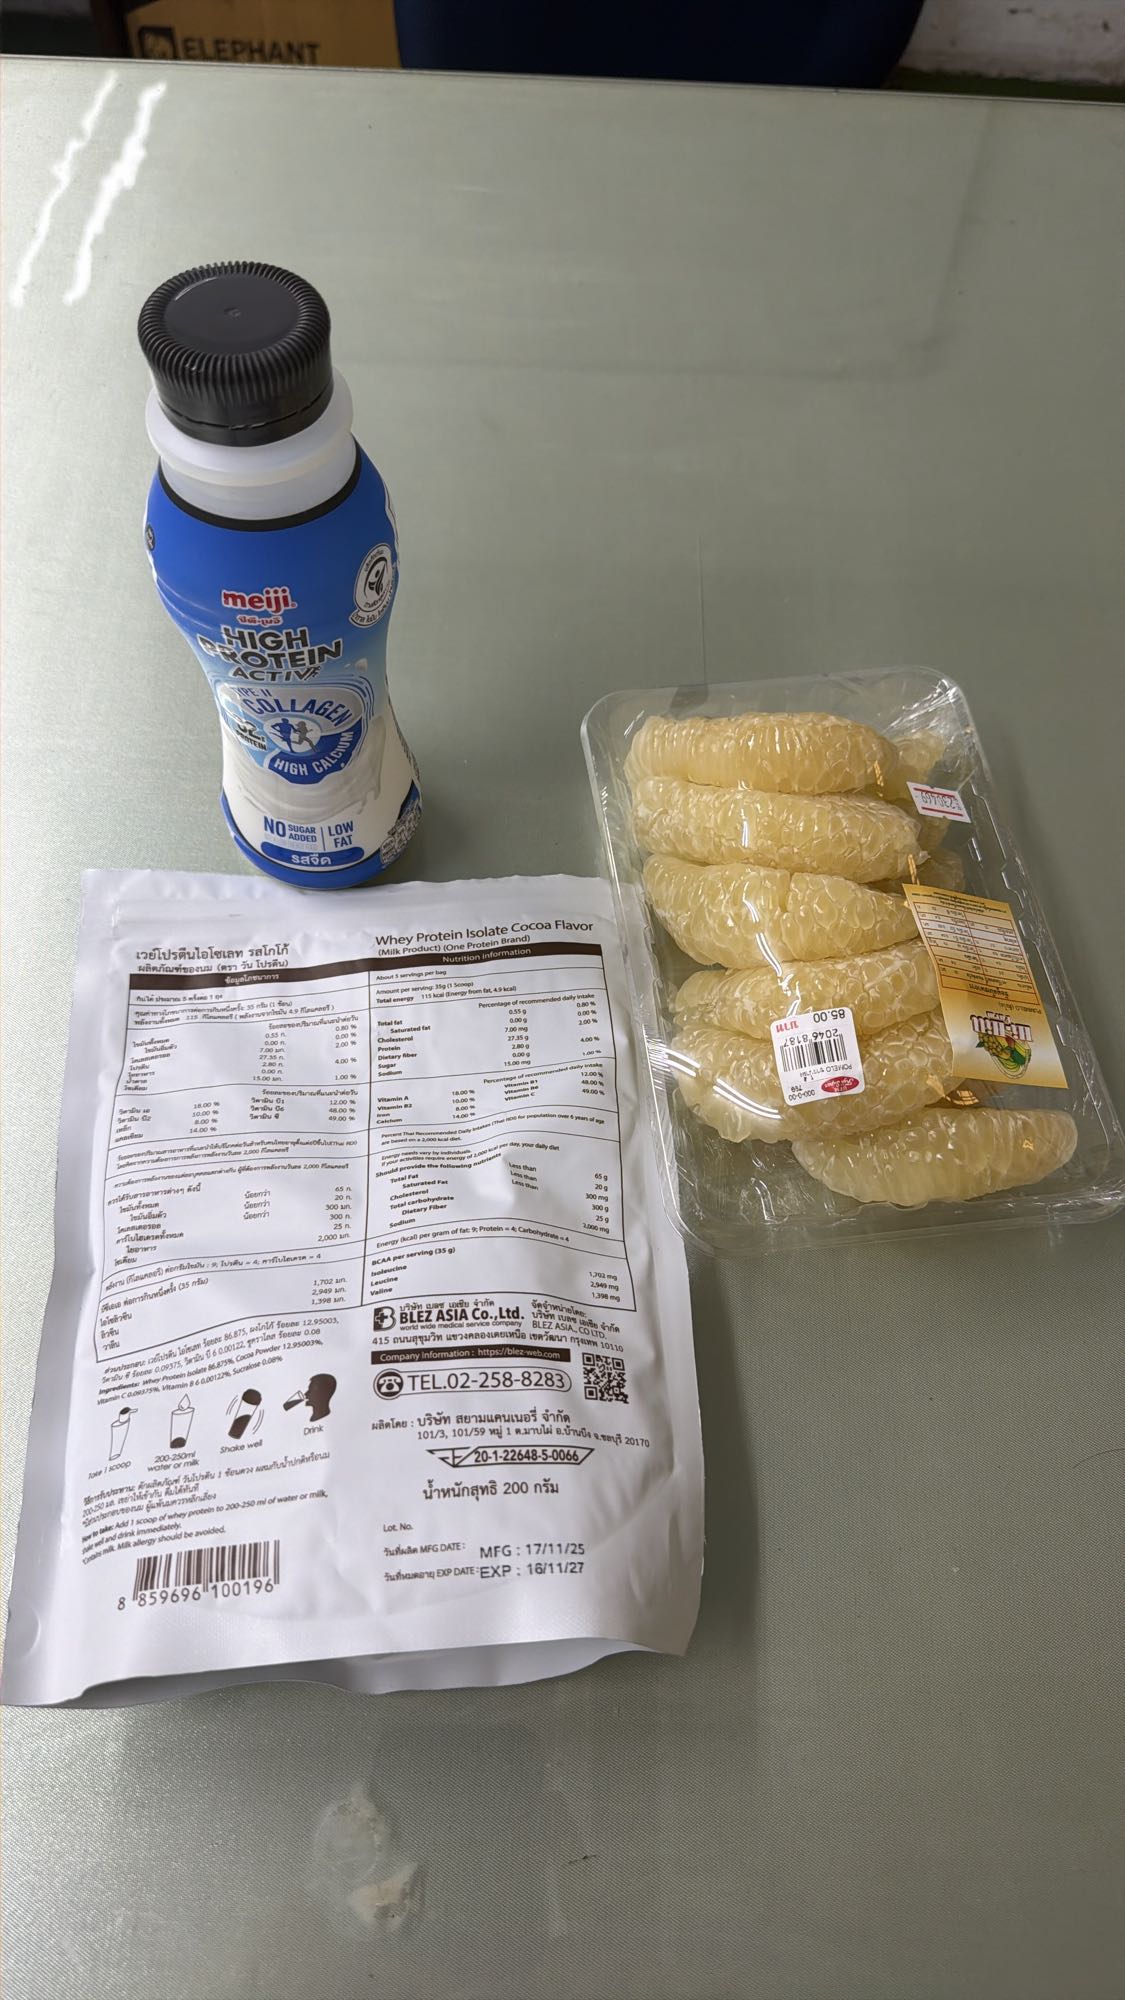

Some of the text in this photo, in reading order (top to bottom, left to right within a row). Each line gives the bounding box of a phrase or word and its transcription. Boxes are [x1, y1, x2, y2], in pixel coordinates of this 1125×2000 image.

[182, 37, 320, 65] ELEPHANT
[222, 587, 291, 614] meiji
[222, 626, 308, 650] HIGH
[198, 634, 342, 669] PROTEIN
[242, 698, 352, 726] COLLAGEN
[274, 732, 354, 776] HIGH CALCIUM
[264, 816, 286, 837] NO
[288, 824, 316, 834] SUGAR
[328, 821, 354, 836] LOW
[288, 834, 317, 842] ADDED
[334, 835, 353, 848] FAT
[291, 854, 331, 865] รสจืด
[376, 920, 593, 946] Whey Protein Isolate Cocoa Flavor
[136, 943, 289, 961] เวย์โปรตีนไอโซเลท รสโกโก้
[403, 945, 440, 954] Product)
[443, 944, 464, 952] (One
[467, 938, 499, 950] Protein
[501, 935, 530, 945] Brand)
[443, 948, 531, 963] Nutrition Information
[217, 964, 237, 972] (ตรา
[241, 961, 253, 969] วัน
[256, 960, 289, 968] โปรตีน)
[813, 1009, 846, 1023] 85.00
[776, 1020, 799, 1032] บาท
[783, 1028, 838, 1047] 2046 8187
[377, 1237, 398, 1248] Energy
[400, 1233, 418, 1243] (kcal)
[431, 1230, 449, 1238] gram
[518, 1226, 558, 1240] Carbohydrate
[372, 1257, 391, 1266] BCAA
[406, 1249, 433, 1258] serving
[371, 1264, 407, 1276] Isoleucine
[607, 1273, 618, 1281] mg
[370, 1276, 398, 1286] Leucine
[608, 1283, 619, 1291] mg
[370, 1287, 392, 1296] Valine
[592, 1292, 620, 1302] 1,398 mg
[400, 1302, 422, 1312] บริษัท
[474, 1298, 495, 1307] จำกัด
[400, 1306, 524, 1324] BLEZ ASIA Co.,Ltd.
[532, 1310, 555, 1320] บริษัท
[600, 1322, 620, 1333] จำกัด
[438, 1321, 464, 1329] medical
[492, 1320, 522, 1328] company
[532, 1320, 552, 1329] BLEZ
[579, 1327, 590, 1336] CO
[592, 1330, 607, 1340] LTD.
[372, 1337, 389, 1345] 415
[393, 1332, 442, 1346] ถนนสุขุมวิท
[446, 1329, 526, 1341] แขวงคลองเตยเหนือ
[570, 1335, 598, 1347] กรุงเทพ
[600, 1341, 624, 1352] 10110
[380, 1347, 560, 1362] Company Information https://blez-web.com
[407, 1370, 565, 1391] TEL.02-258-8283
[371, 1405, 570, 1430] ผลิตโดย บริษัท สยามแคนเนอรี่ จำกัด
[304, 1425, 324, 1436] Drink
[417, 1429, 448, 1440] 101/3,
[452, 1428, 486, 1438] 101/59
[488, 1425, 503, 1439] หมู่
[506, 1427, 511, 1435] 1
[556, 1425, 591, 1438] อ.บ้านบึง
[594, 1433, 622, 1446] จ.ชลบุรี
[625, 1436, 650, 1448] 20170
[220, 1439, 263, 1454] Shake well
[474, 1449, 579, 1463] 20-1-22648-5-0066
[147, 1463, 172, 1472] water
[423, 1478, 559, 1500] น้ำหนักสุทธิ 200 กรัม
[400, 1523, 413, 1531] No.
[420, 1544, 439, 1554] MFG
[480, 1545, 512, 1559] MFG
[526, 1543, 585, 1555] 17/11/25
[436, 1568, 452, 1578] EXP
[480, 1564, 511, 1579] EXP
[527, 1562, 584, 1575] 16/11/27
[117, 1578, 274, 1610] 8 859696 100196
